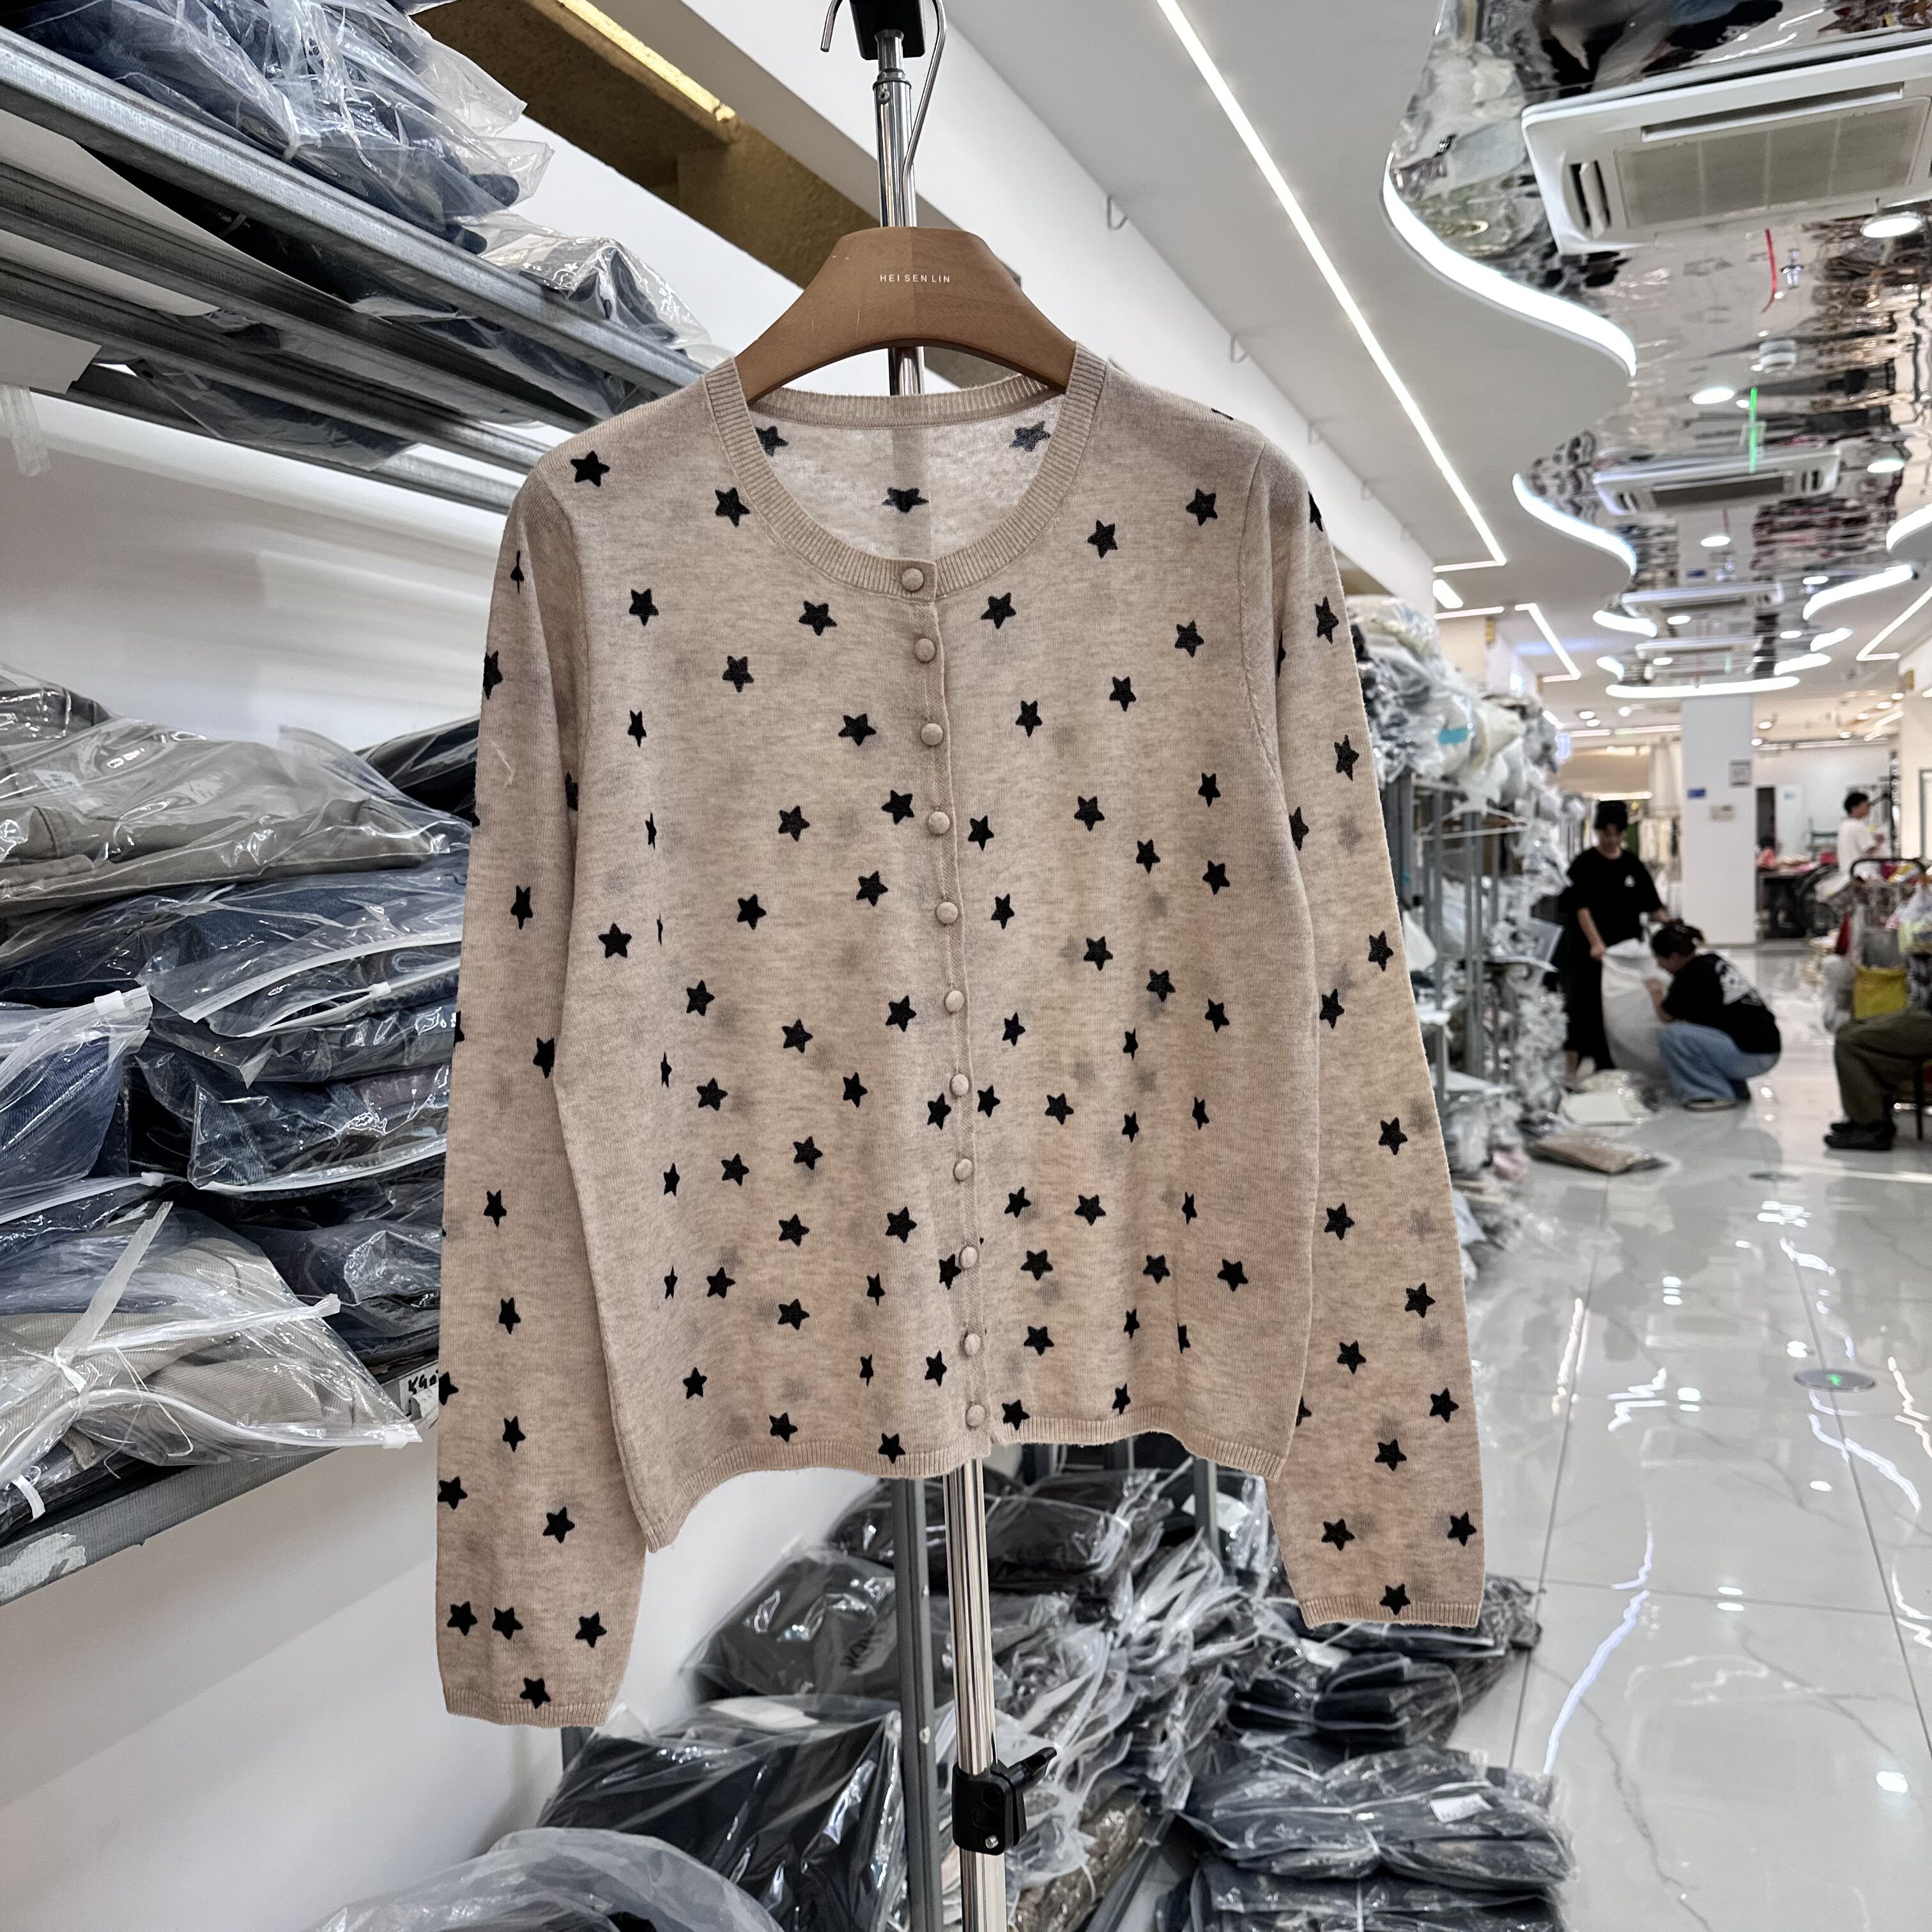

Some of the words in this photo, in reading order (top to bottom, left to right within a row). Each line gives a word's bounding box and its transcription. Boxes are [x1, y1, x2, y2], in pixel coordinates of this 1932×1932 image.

[880, 274, 900, 282] HEI
[904, 274, 927, 282] SEN
[931, 275, 950, 283] LIN
